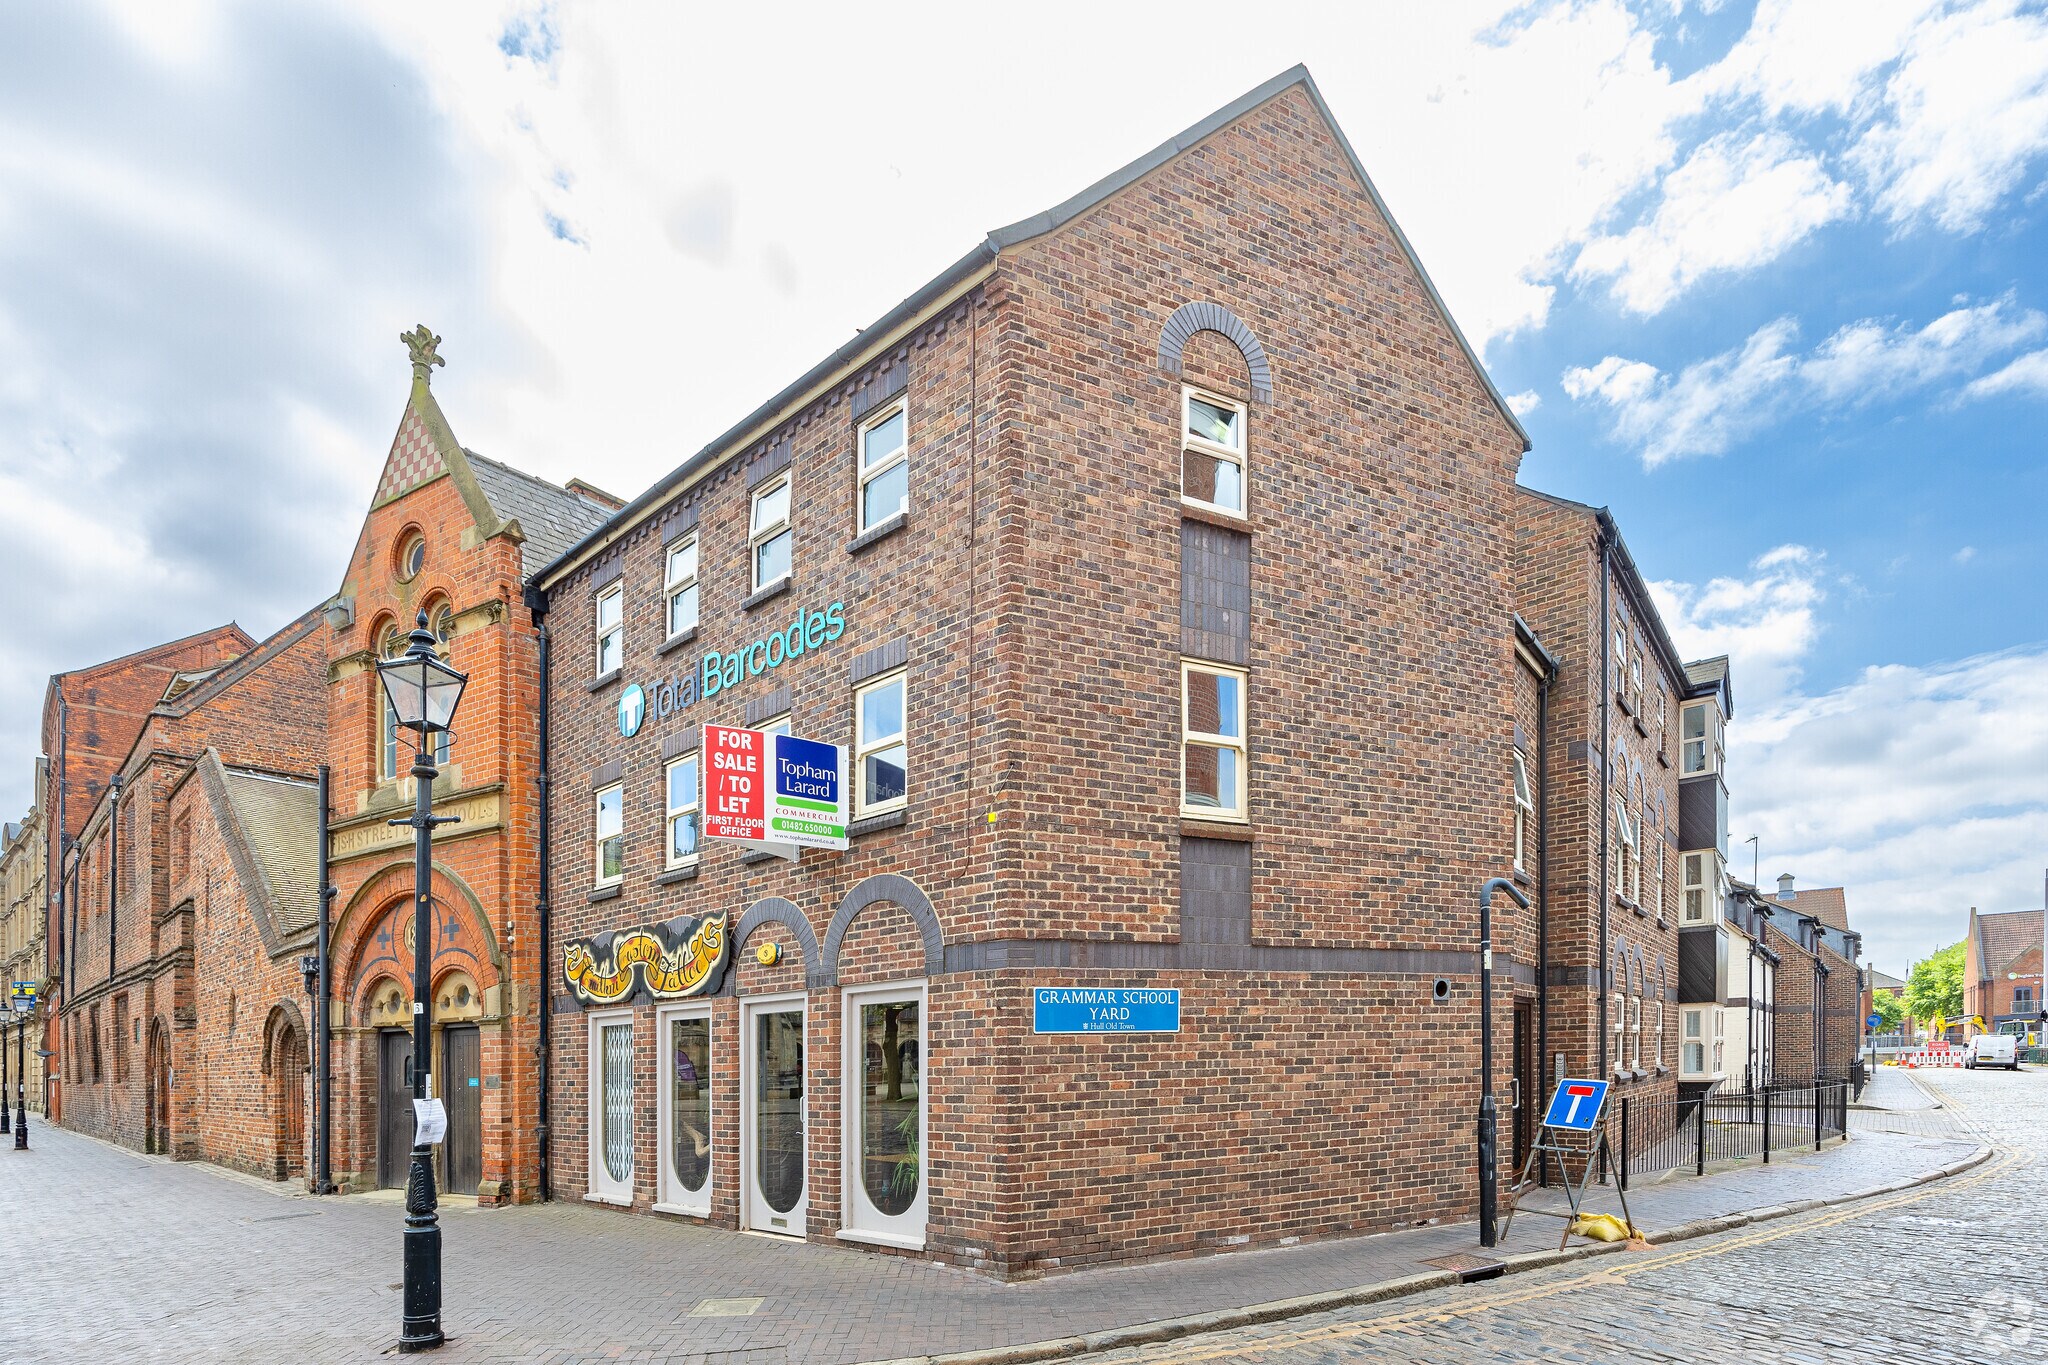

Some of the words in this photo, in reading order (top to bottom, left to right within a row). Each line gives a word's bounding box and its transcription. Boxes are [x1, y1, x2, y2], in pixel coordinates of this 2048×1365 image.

[718, 730, 752, 750] FOR
[714, 752, 757, 773] SALE
[778, 757, 836, 782] Topham
[729, 775, 751, 794] TO
[786, 776, 830, 798] Larard
[718, 795, 750, 814] LET
[707, 815, 733, 826] FIRST
[735, 817, 764, 828] FLOOR
[775, 807, 839, 823] COMMERCIAL
[719, 825, 752, 837] OFFICE
[781, 820, 803, 831] 01482
[804, 823, 833, 835] 650000
[774, 834, 836, 845] www.tophamlarard.co.uk
[656, 950, 702, 993] Tattoo
[1039, 990, 1117, 1004] GRAMMAR
[1123, 991, 1175, 1005] SCHOOL
[1089, 1007, 1130, 1020] YARD
[1090, 1022, 1105, 1030] Hull
[1105, 1022, 1118, 1030] Old
[1118, 1022, 1136, 1030] Town
